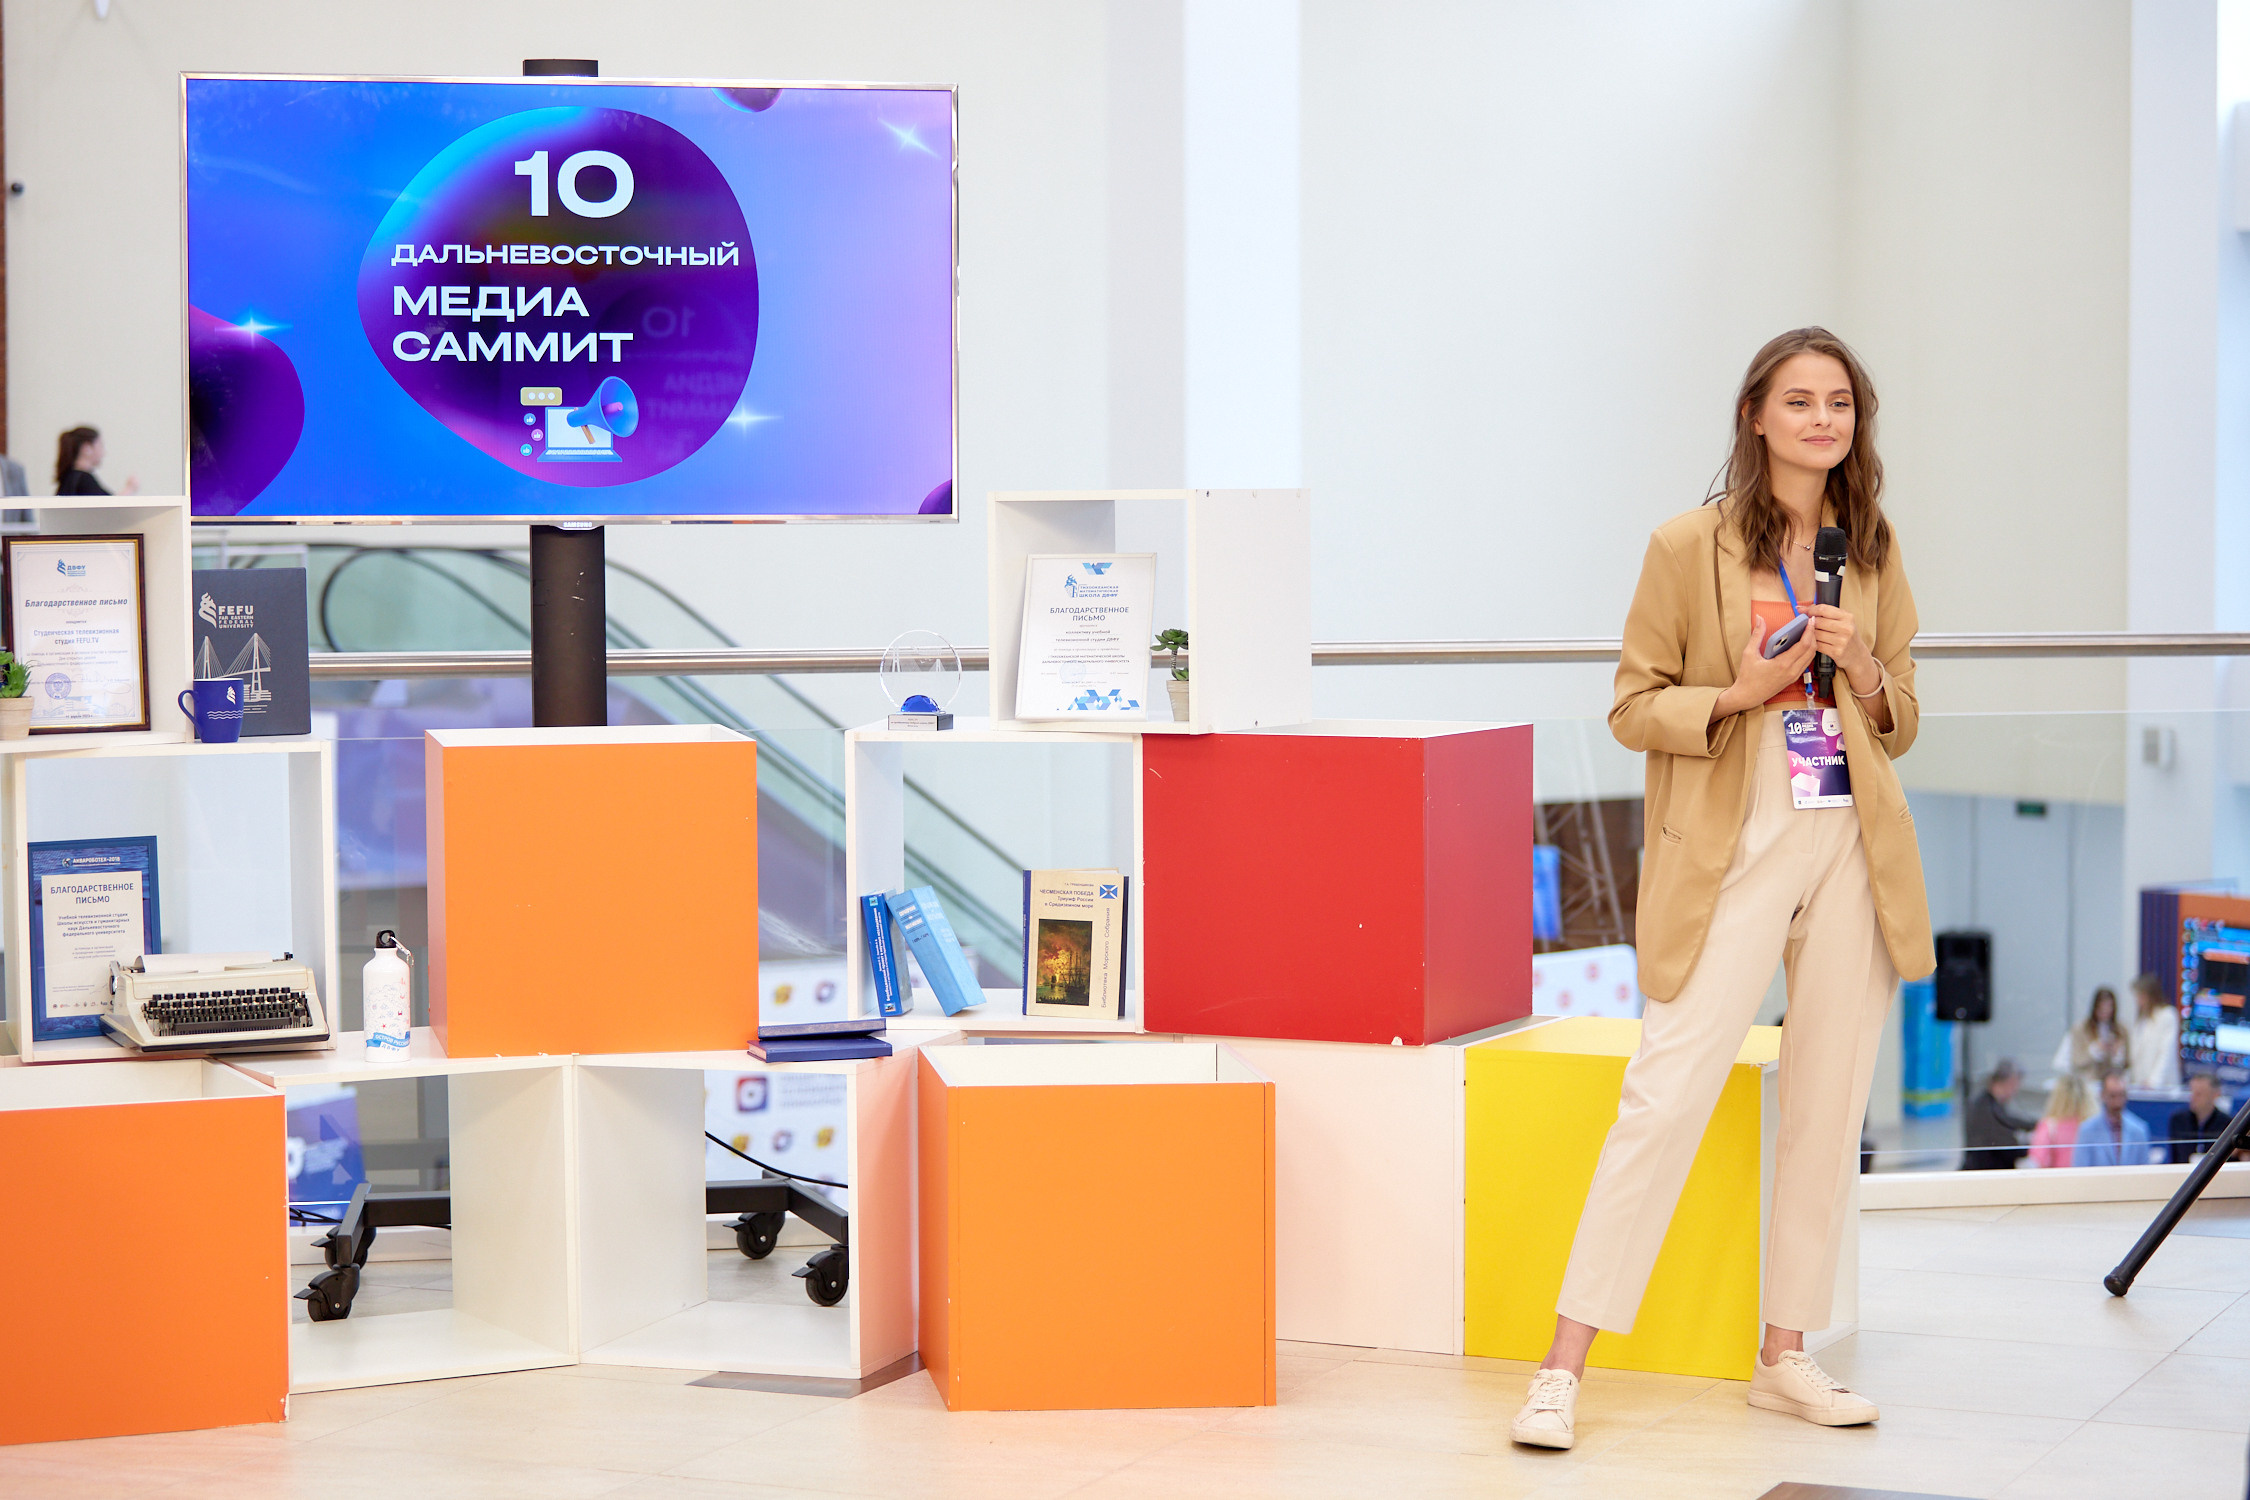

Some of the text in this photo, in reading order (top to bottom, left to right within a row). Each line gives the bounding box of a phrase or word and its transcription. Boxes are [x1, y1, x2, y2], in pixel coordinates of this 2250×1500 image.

[514, 150, 635, 218] 10
[391, 241, 740, 267] ДАЛЬНЕВОСТОЧНЫЙ
[393, 286, 590, 323] МЕДИА
[392, 331, 634, 363] САММИТ
[25, 598, 128, 608] Благодарственное письмо
[218, 605, 254, 615] FEFU
[1050, 606, 1129, 614] БЛАГОДАРСТВЕННОЕ
[1788, 722, 1803, 735] 10
[1791, 755, 1846, 768] УЧАСТНИК
[50, 882, 134, 895] БЛАГОДАРСТВЕННОЕ
[75, 895, 110, 905] ПИСЬМО
